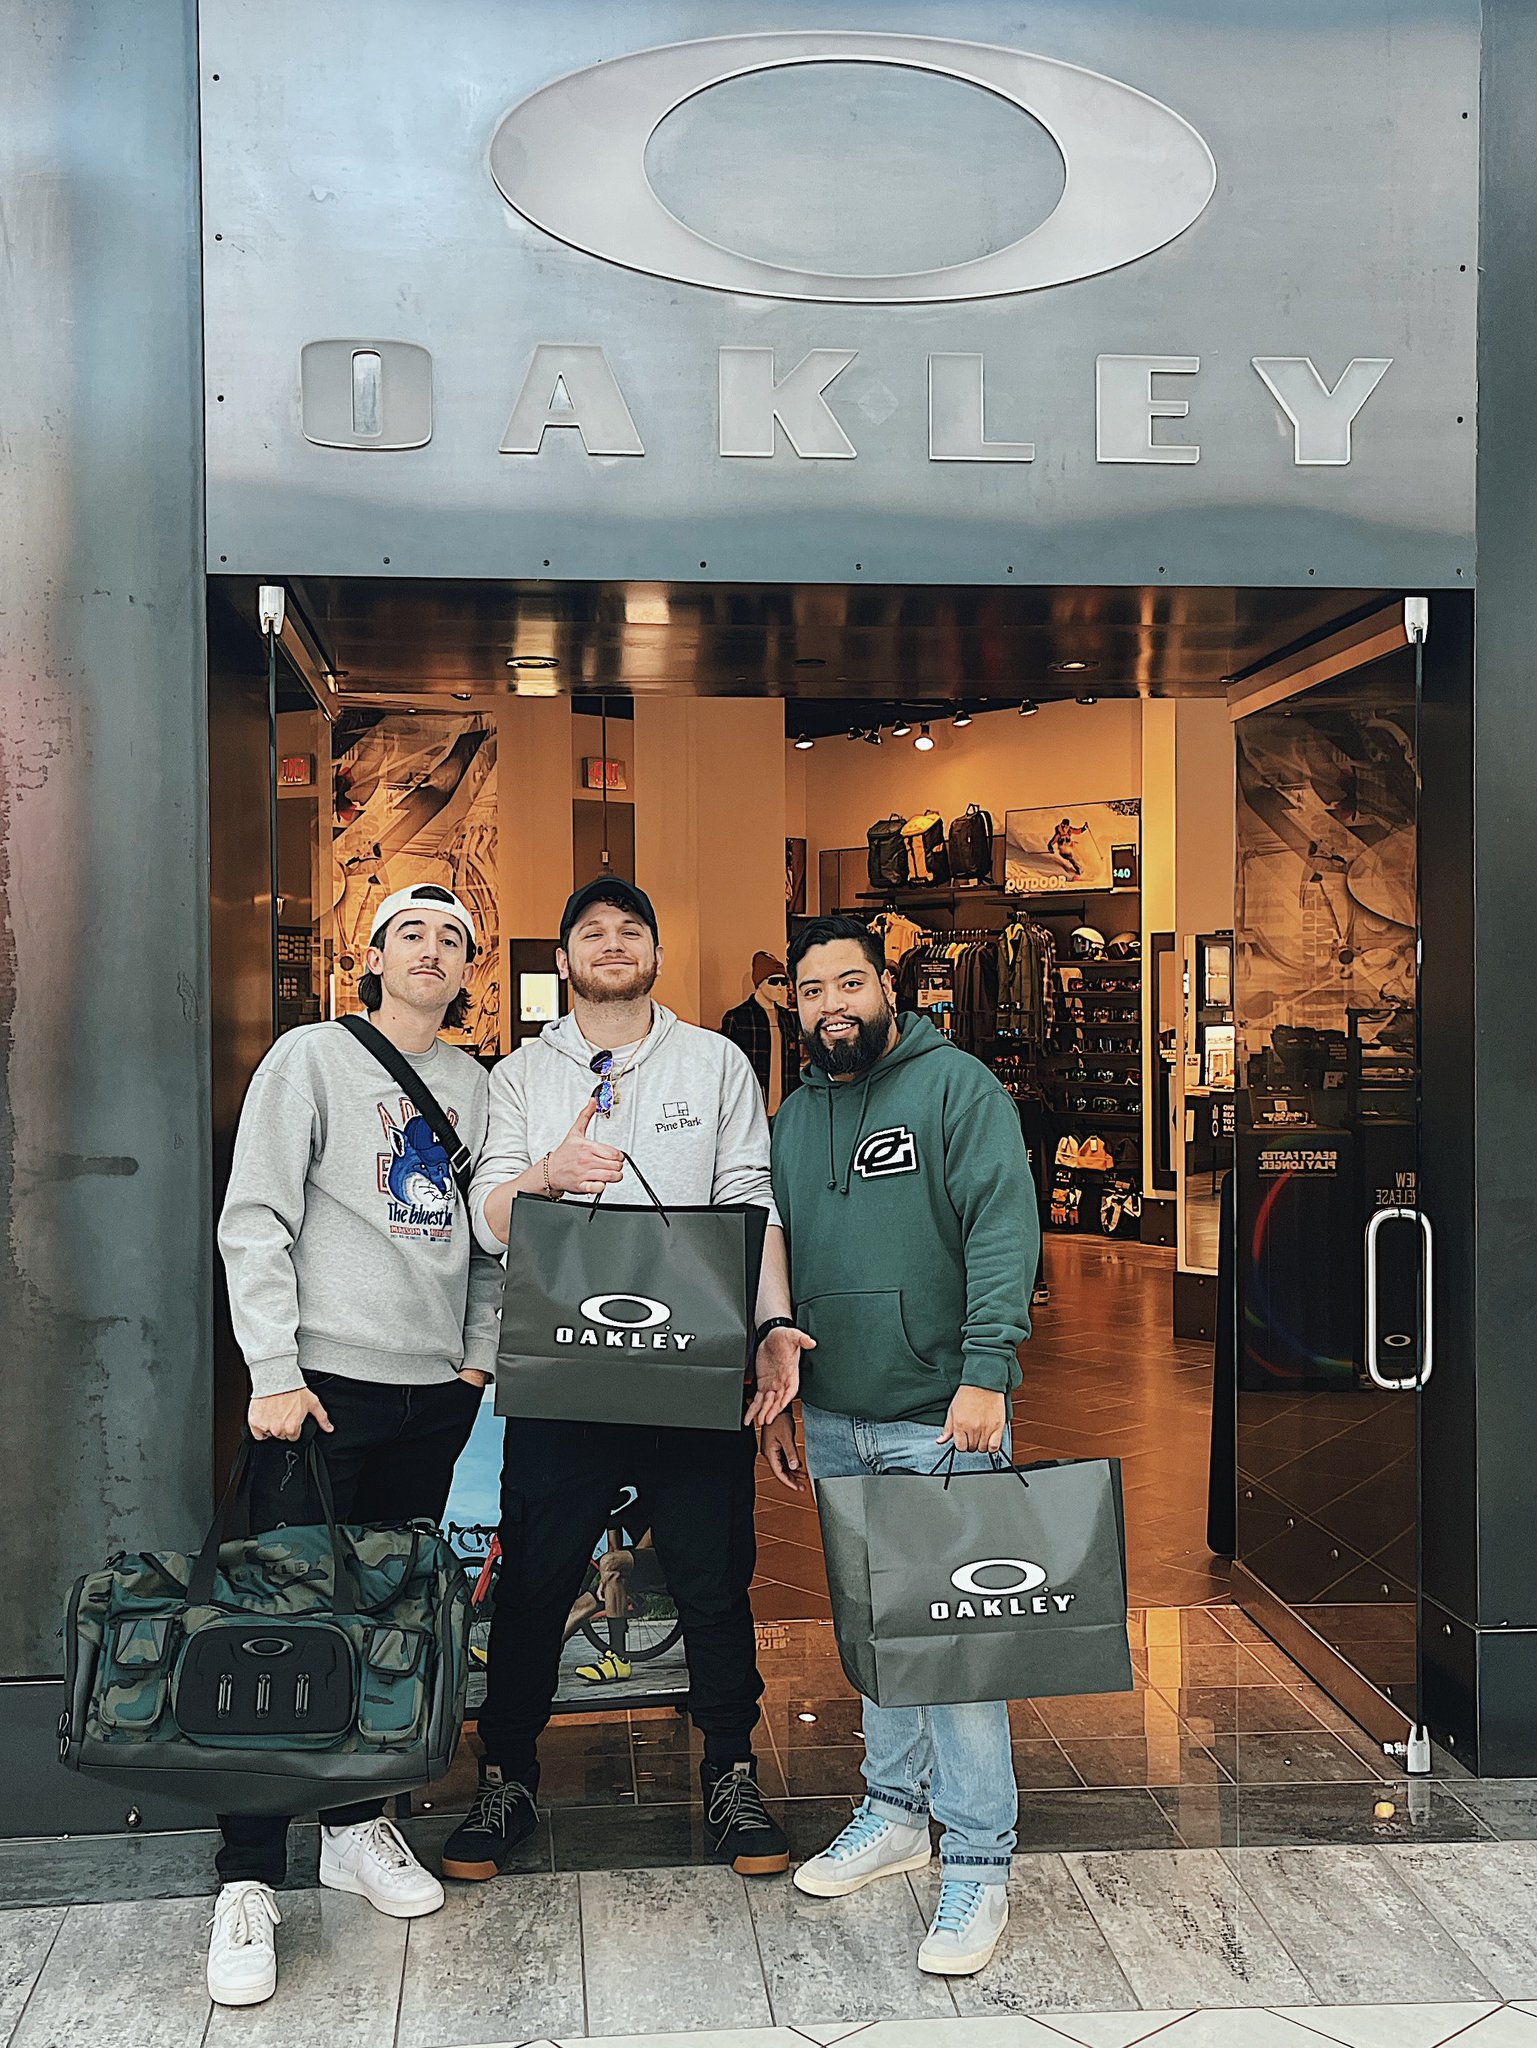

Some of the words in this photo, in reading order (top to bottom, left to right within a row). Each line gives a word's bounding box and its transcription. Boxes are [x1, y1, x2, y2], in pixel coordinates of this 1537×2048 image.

[301, 338, 1394, 466] OAKLEY
[1006, 876, 1068, 892] OUTDOOR
[1113, 868, 1131, 879] $40
[655, 1122, 678, 1133] Pine
[679, 1116, 702, 1129] Park
[387, 1201, 409, 1224] The
[556, 1327, 691, 1350] OAKLEY
[930, 1594, 1071, 1620] OAKLEY
